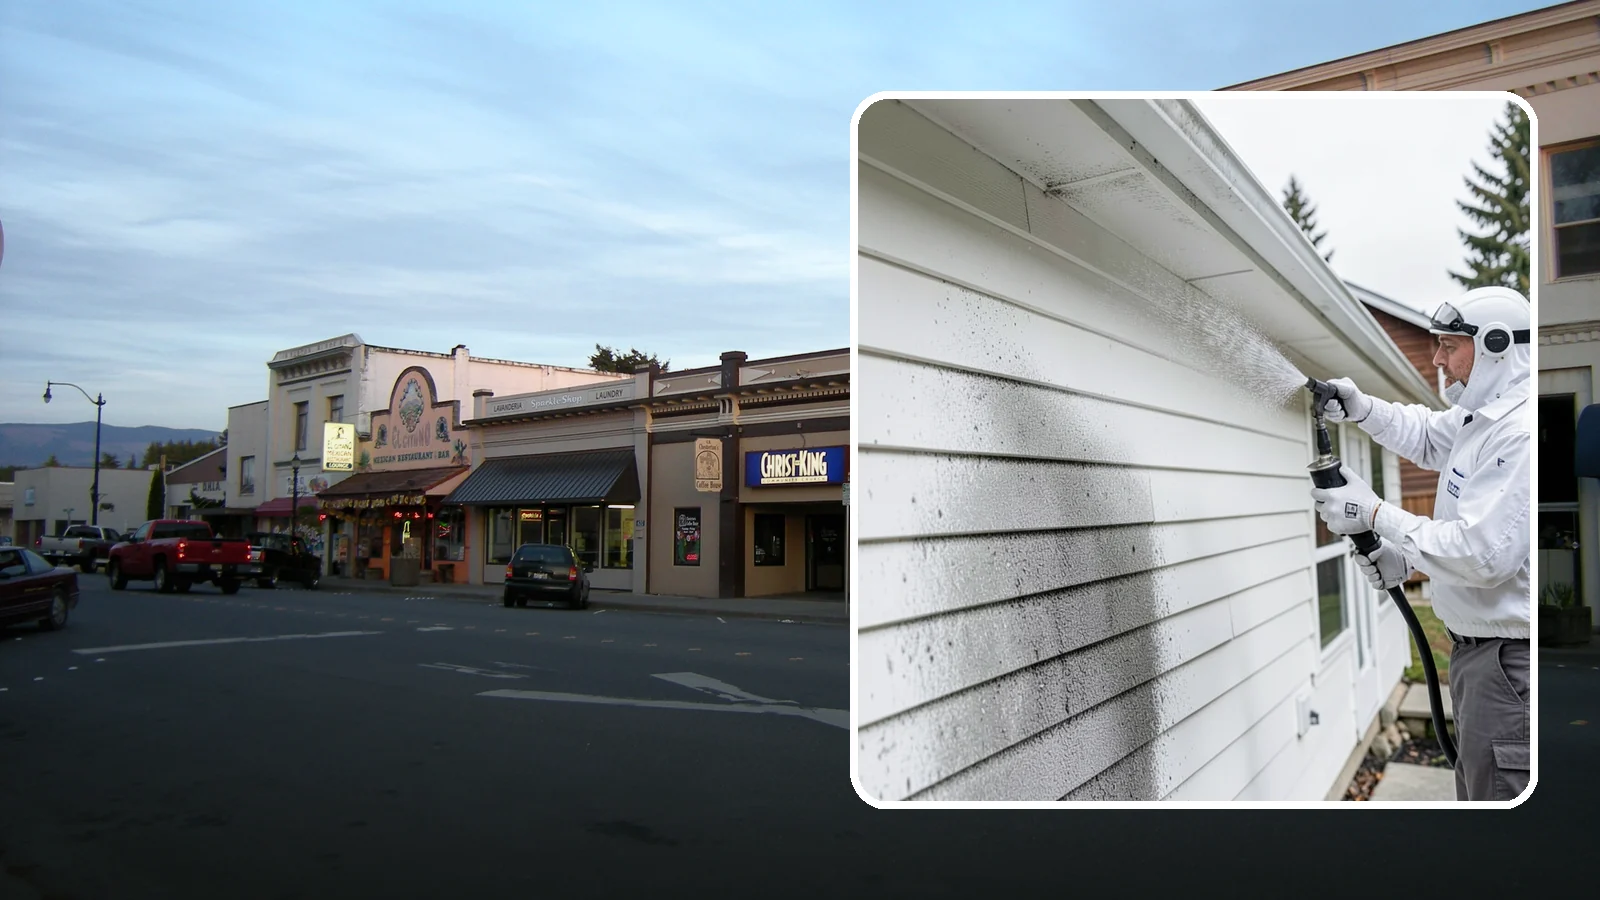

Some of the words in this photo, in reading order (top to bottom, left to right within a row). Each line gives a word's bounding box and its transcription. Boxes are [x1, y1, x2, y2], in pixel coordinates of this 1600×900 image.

[596, 389, 624, 400] LAUNDRY
[493, 402, 522, 413] LAVANDERIA
[531, 396, 561, 409] Sparkle
[562, 394, 582, 406] Shop
[374, 455, 396, 464] MEXICAN
[397, 451, 433, 462] RESTAURANT
[438, 450, 450, 459] BAR
[761, 452, 798, 478] CHRIST
[799, 450, 828, 477] KING
[696, 481, 709, 489] Coffee
